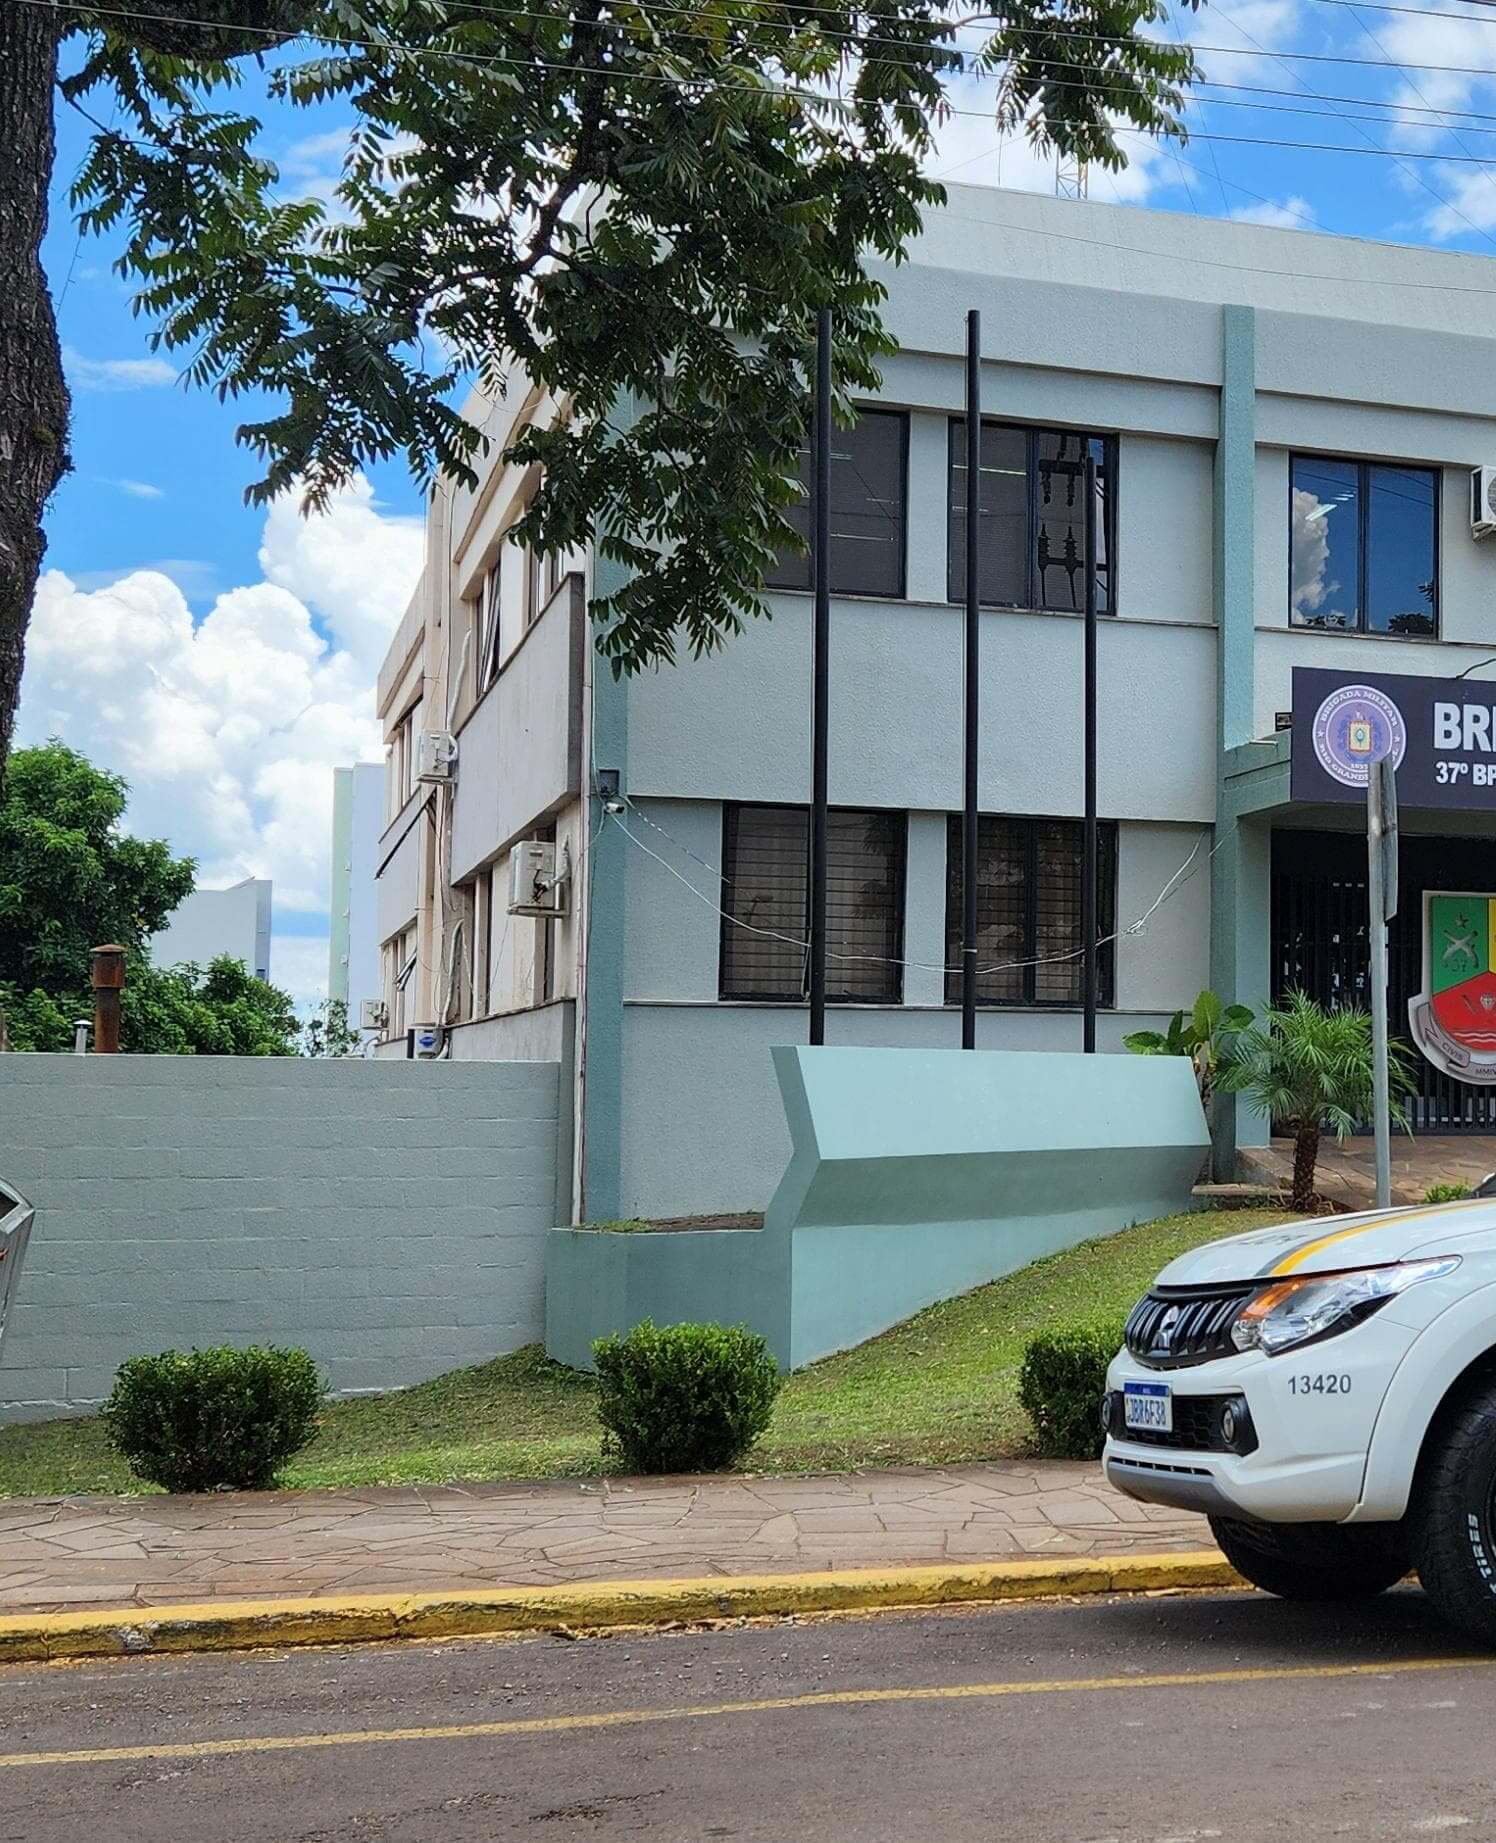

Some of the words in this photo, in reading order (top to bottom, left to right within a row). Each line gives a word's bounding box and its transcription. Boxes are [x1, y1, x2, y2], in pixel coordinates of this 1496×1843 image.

[1320, 690, 1361, 722] BRIGADA
[1363, 691, 1398, 726] MILITAR
[1288, 1374, 1352, 1394] 13420
